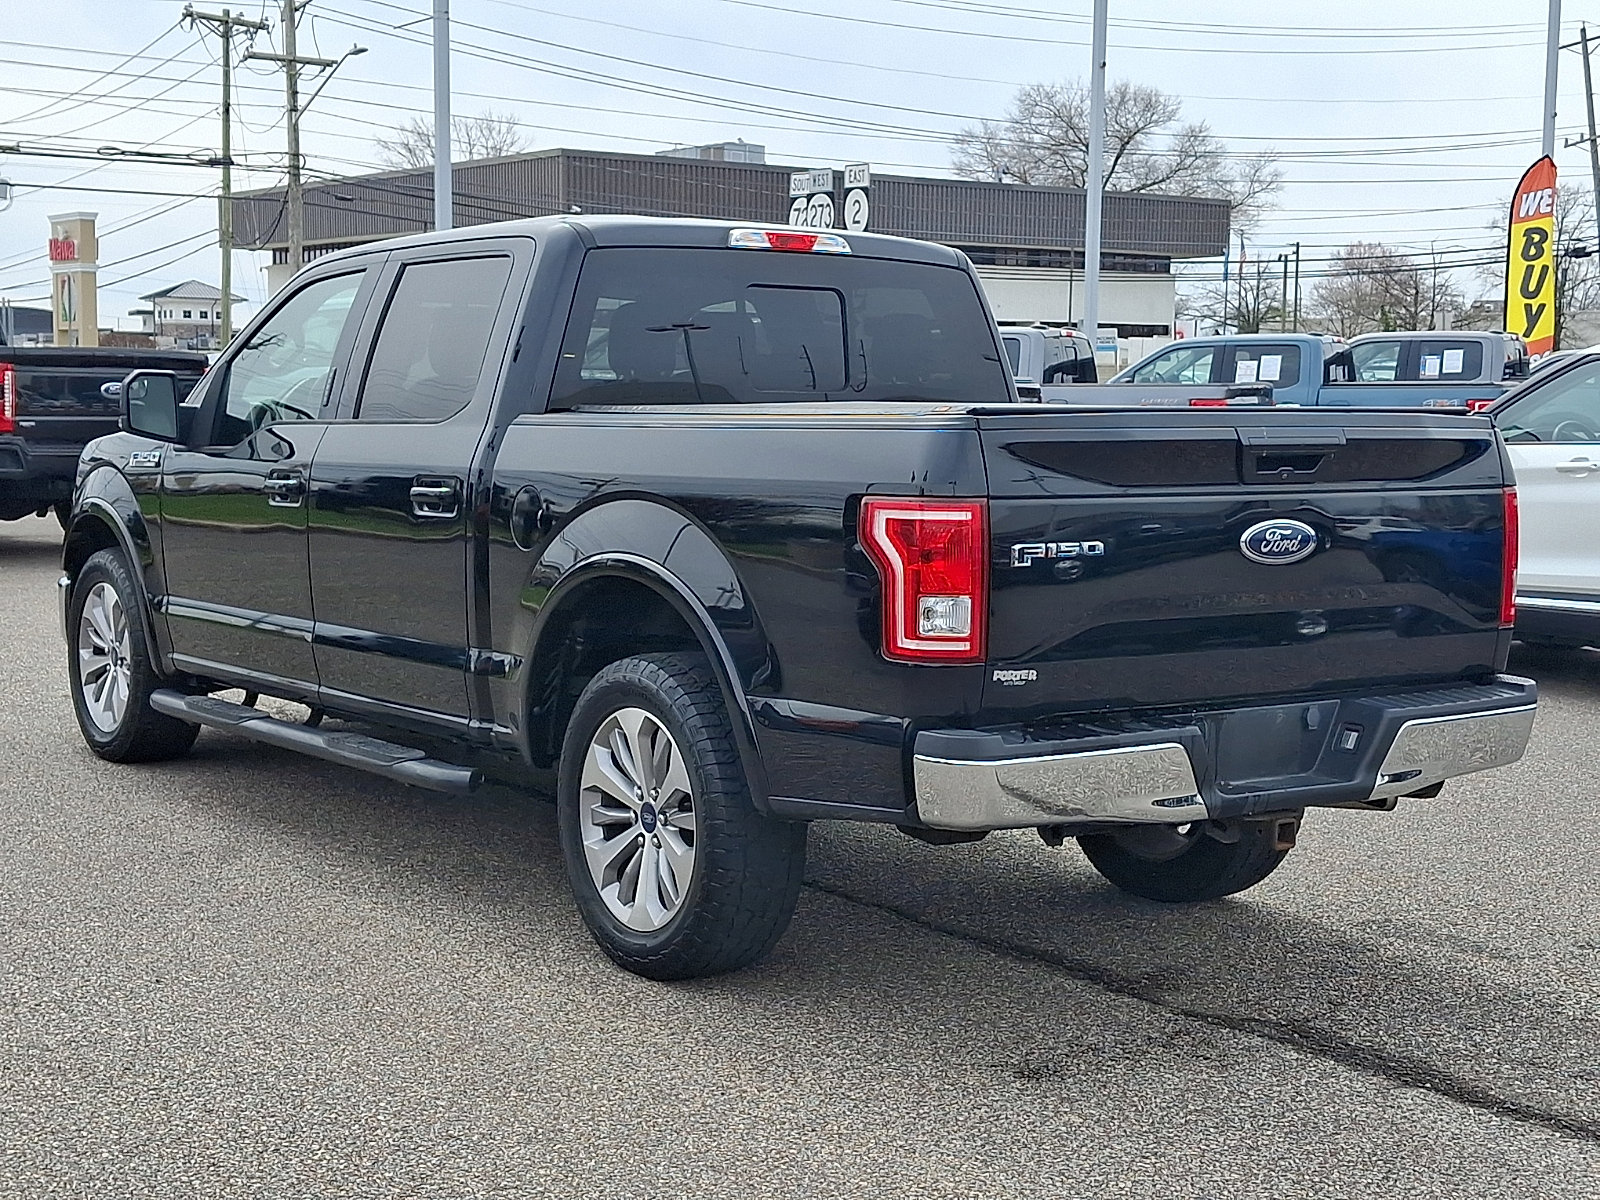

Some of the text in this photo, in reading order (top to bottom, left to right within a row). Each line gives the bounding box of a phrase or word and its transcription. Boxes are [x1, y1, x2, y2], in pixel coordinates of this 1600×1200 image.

[792, 178, 810, 192] SOUT
[812, 173, 829, 187] WEST
[849, 169, 865, 184] EAST
[852, 199, 862, 225] 2
[1518, 187, 1553, 218] WE
[809, 203, 832, 228] 273
[49, 237, 75, 259] Wawa
[1519, 226, 1549, 339] BUY
[1260, 527, 1302, 554] Ford
[1010, 540, 1105, 568] F150
[992, 669, 1038, 682] PORTER
